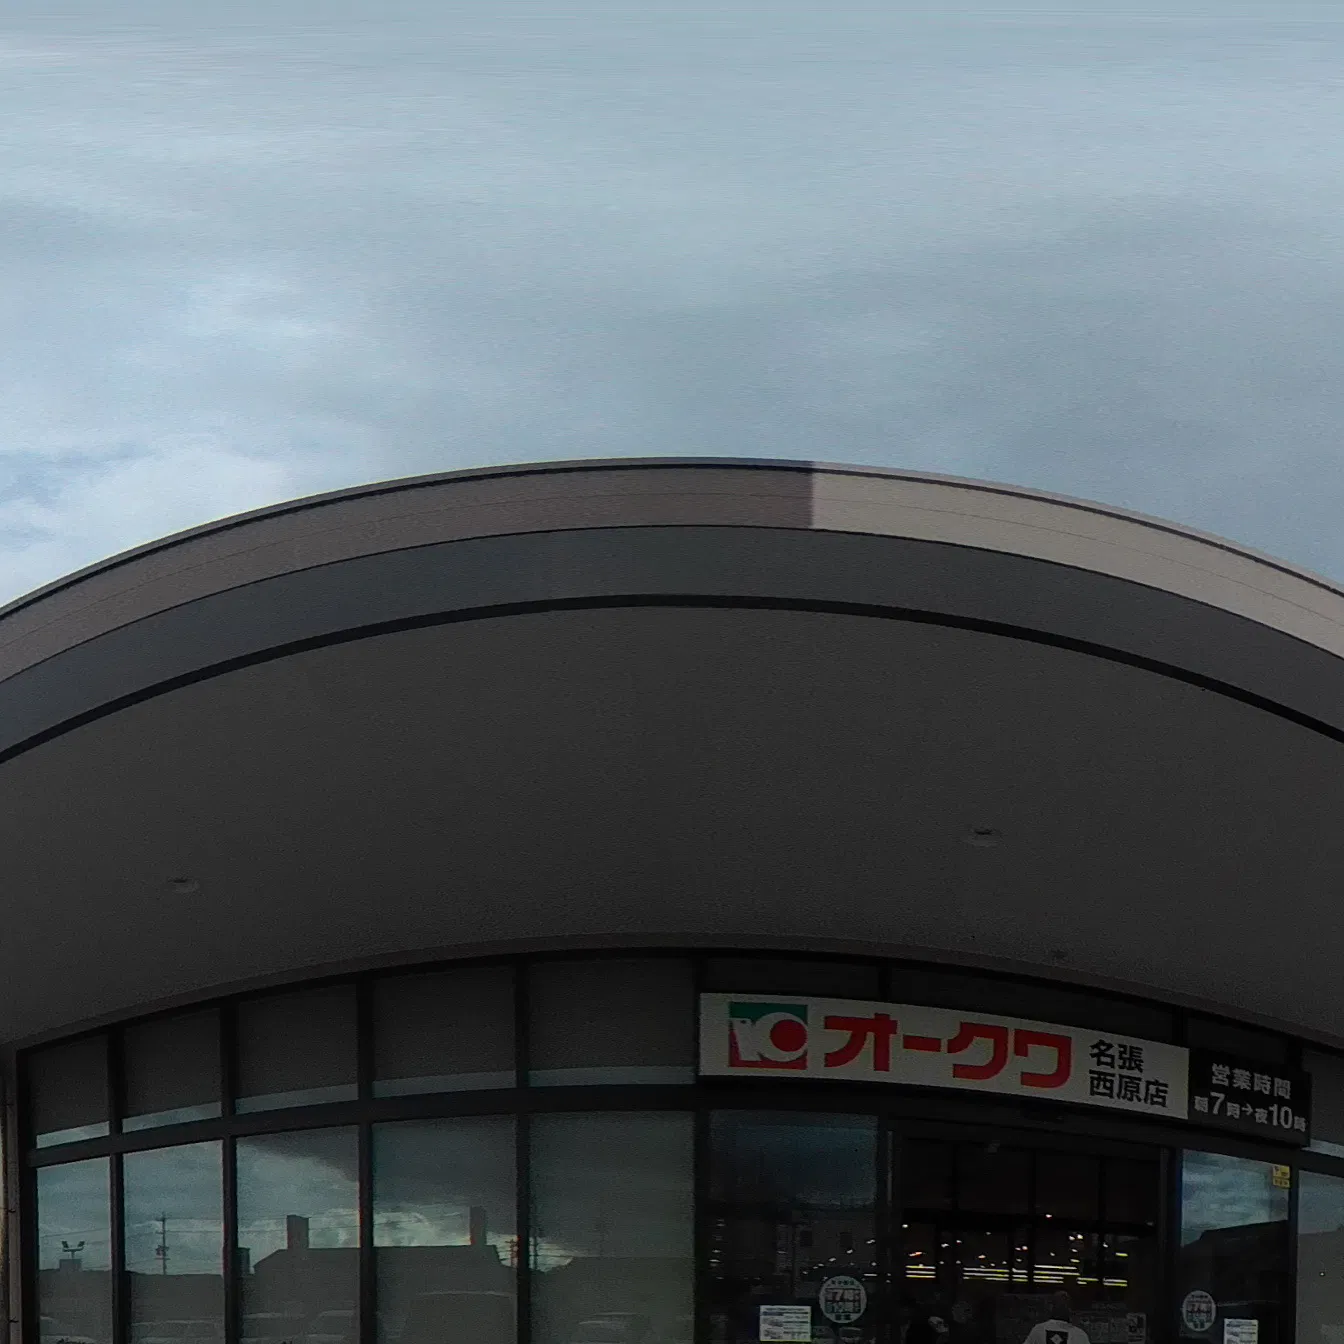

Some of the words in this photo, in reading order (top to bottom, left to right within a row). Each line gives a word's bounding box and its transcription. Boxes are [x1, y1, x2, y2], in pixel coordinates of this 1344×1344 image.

[824, 1013, 1072, 1088] オークワ
[1089, 1039, 1144, 1073] 名張
[1089, 1069, 1169, 1107] 西原店
[1211, 1063, 1292, 1100] 営業時間
